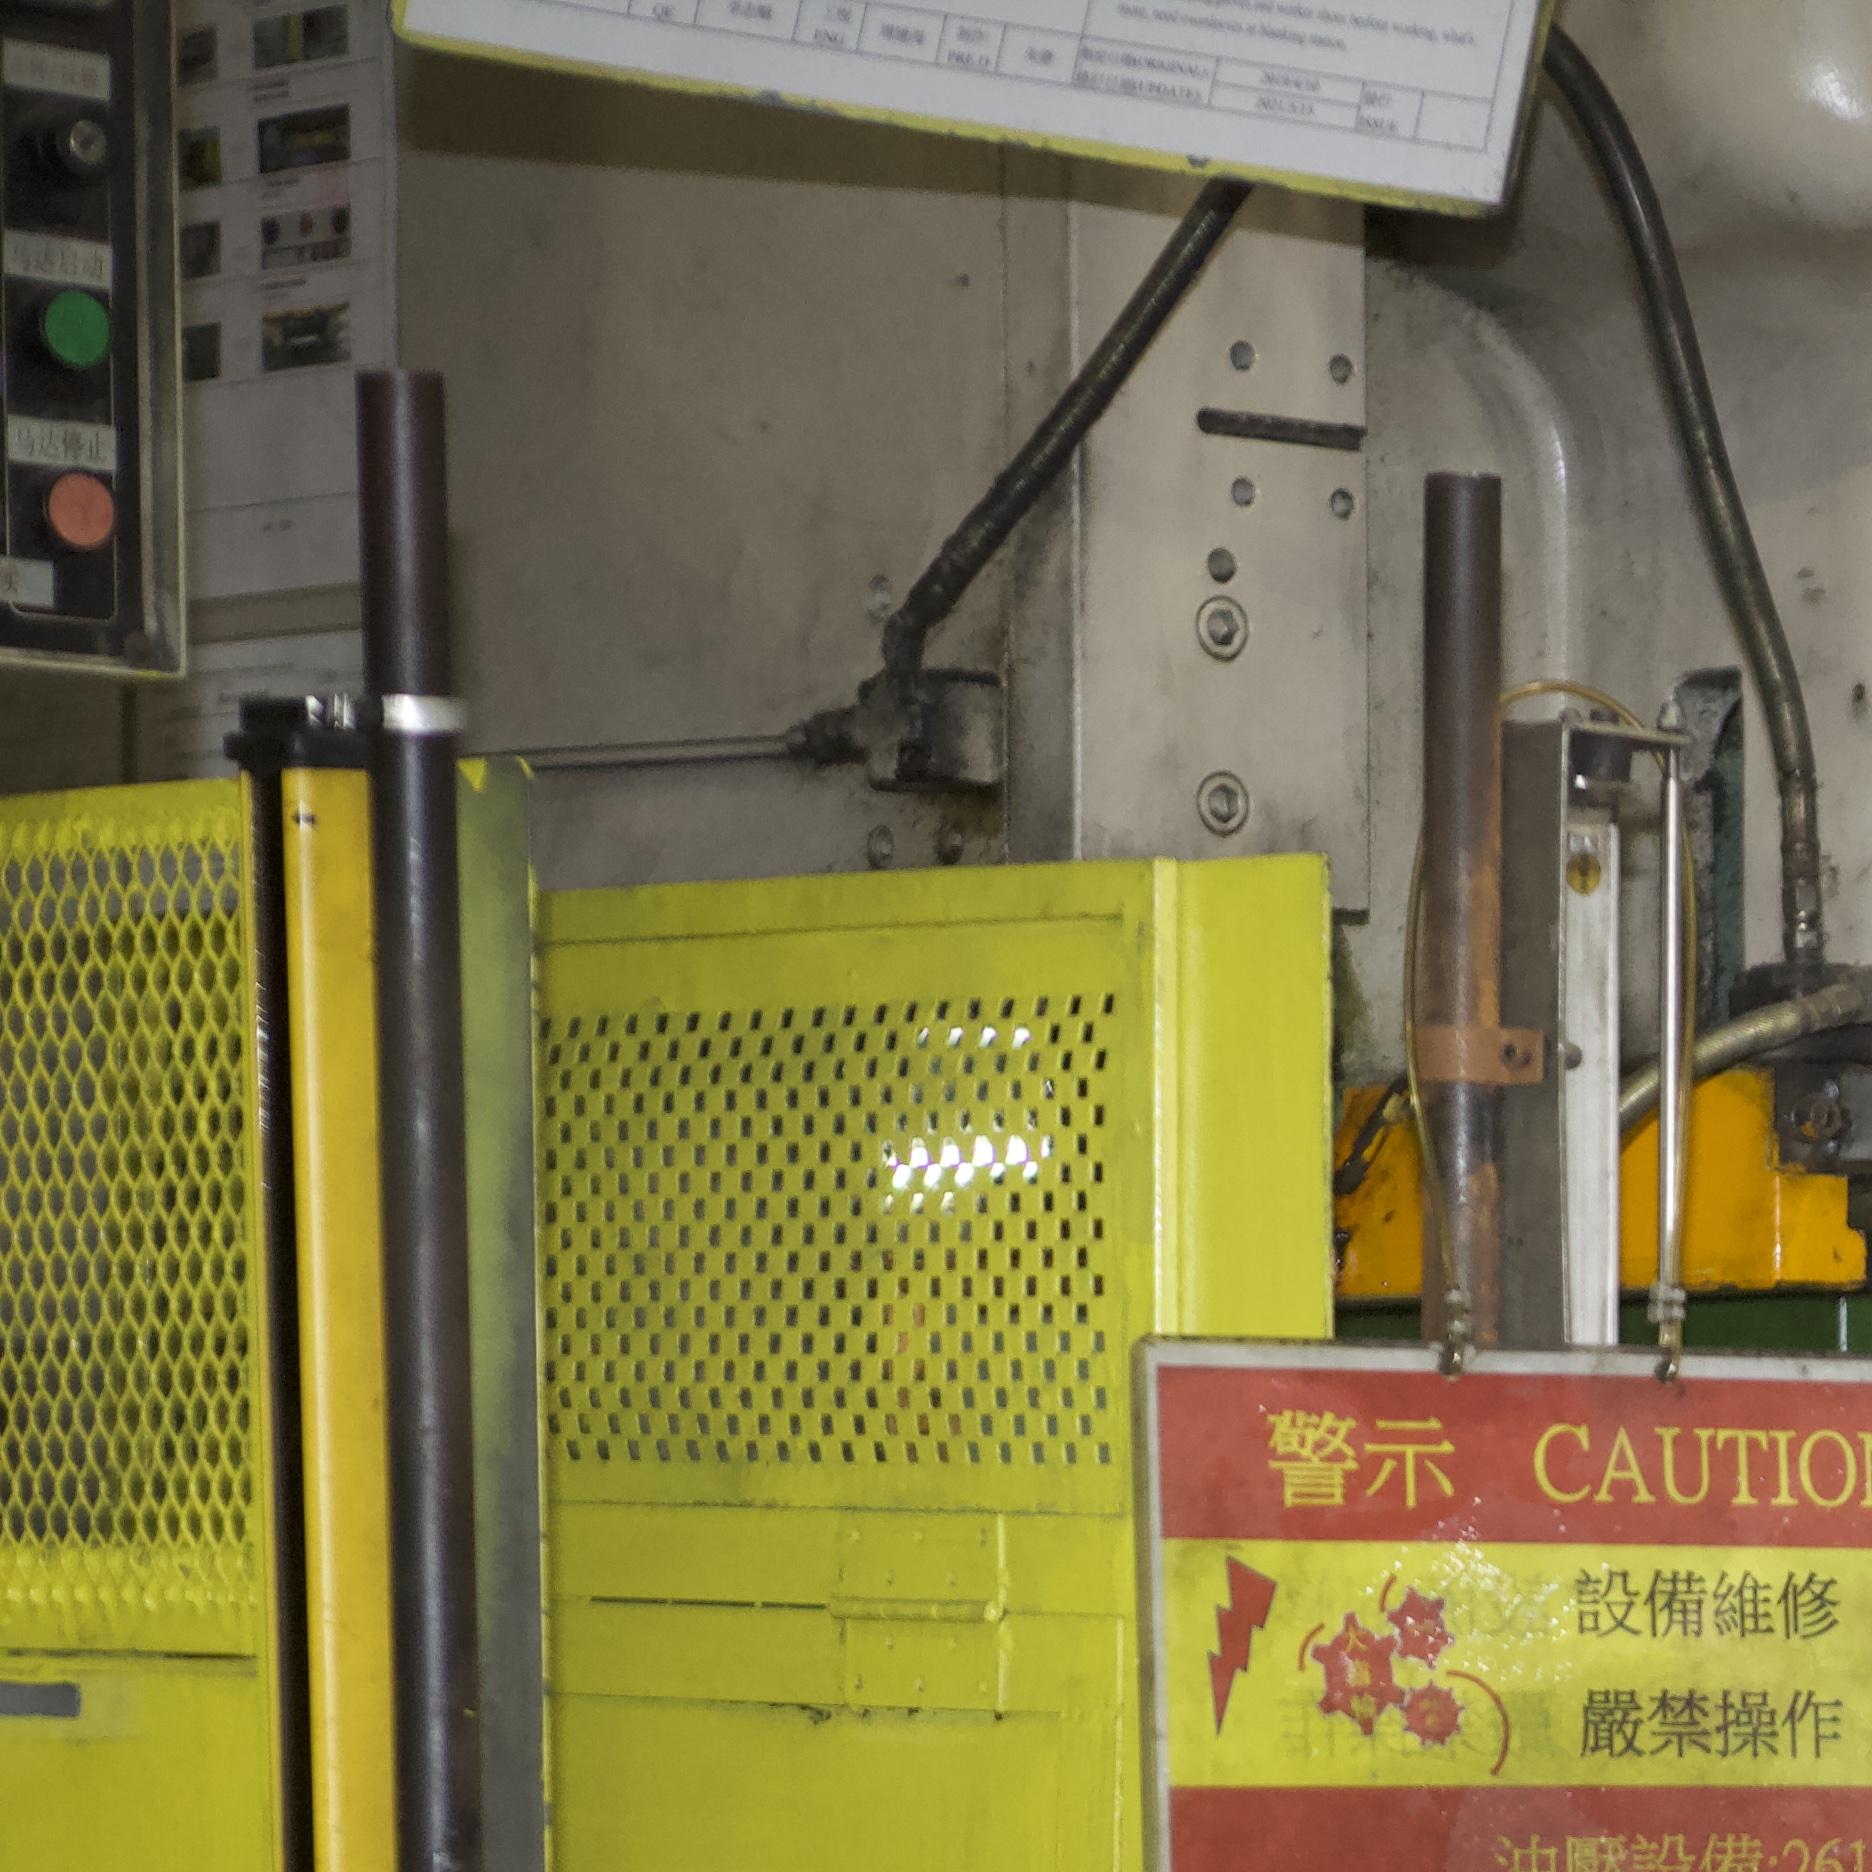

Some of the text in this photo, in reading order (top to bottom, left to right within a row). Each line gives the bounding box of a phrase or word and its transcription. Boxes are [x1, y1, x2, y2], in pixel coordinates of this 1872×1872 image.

[1266, 1408, 1455, 1510] 警示
[1574, 1567, 1842, 1641] 設備維修
[1579, 1687, 1844, 1759] 嚴禁操作
